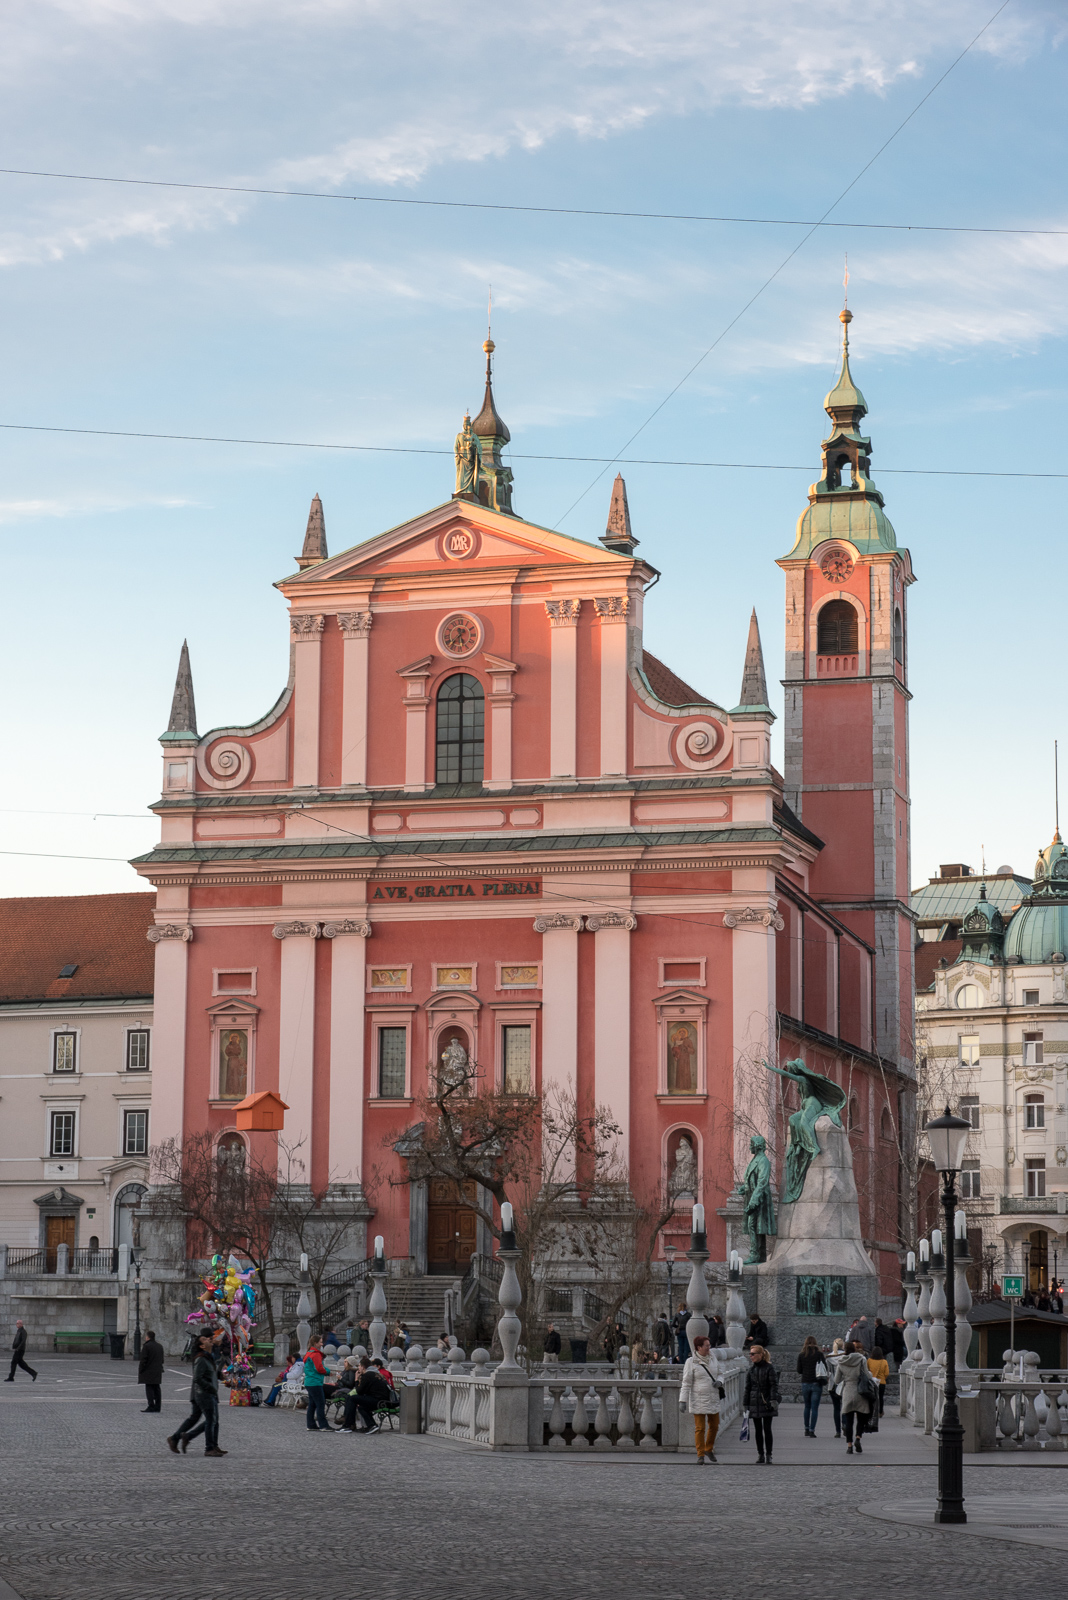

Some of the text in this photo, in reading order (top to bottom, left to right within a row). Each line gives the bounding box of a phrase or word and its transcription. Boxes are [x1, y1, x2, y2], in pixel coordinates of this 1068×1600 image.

[373, 882, 540, 902] AVE, GRATIA PLENA!
